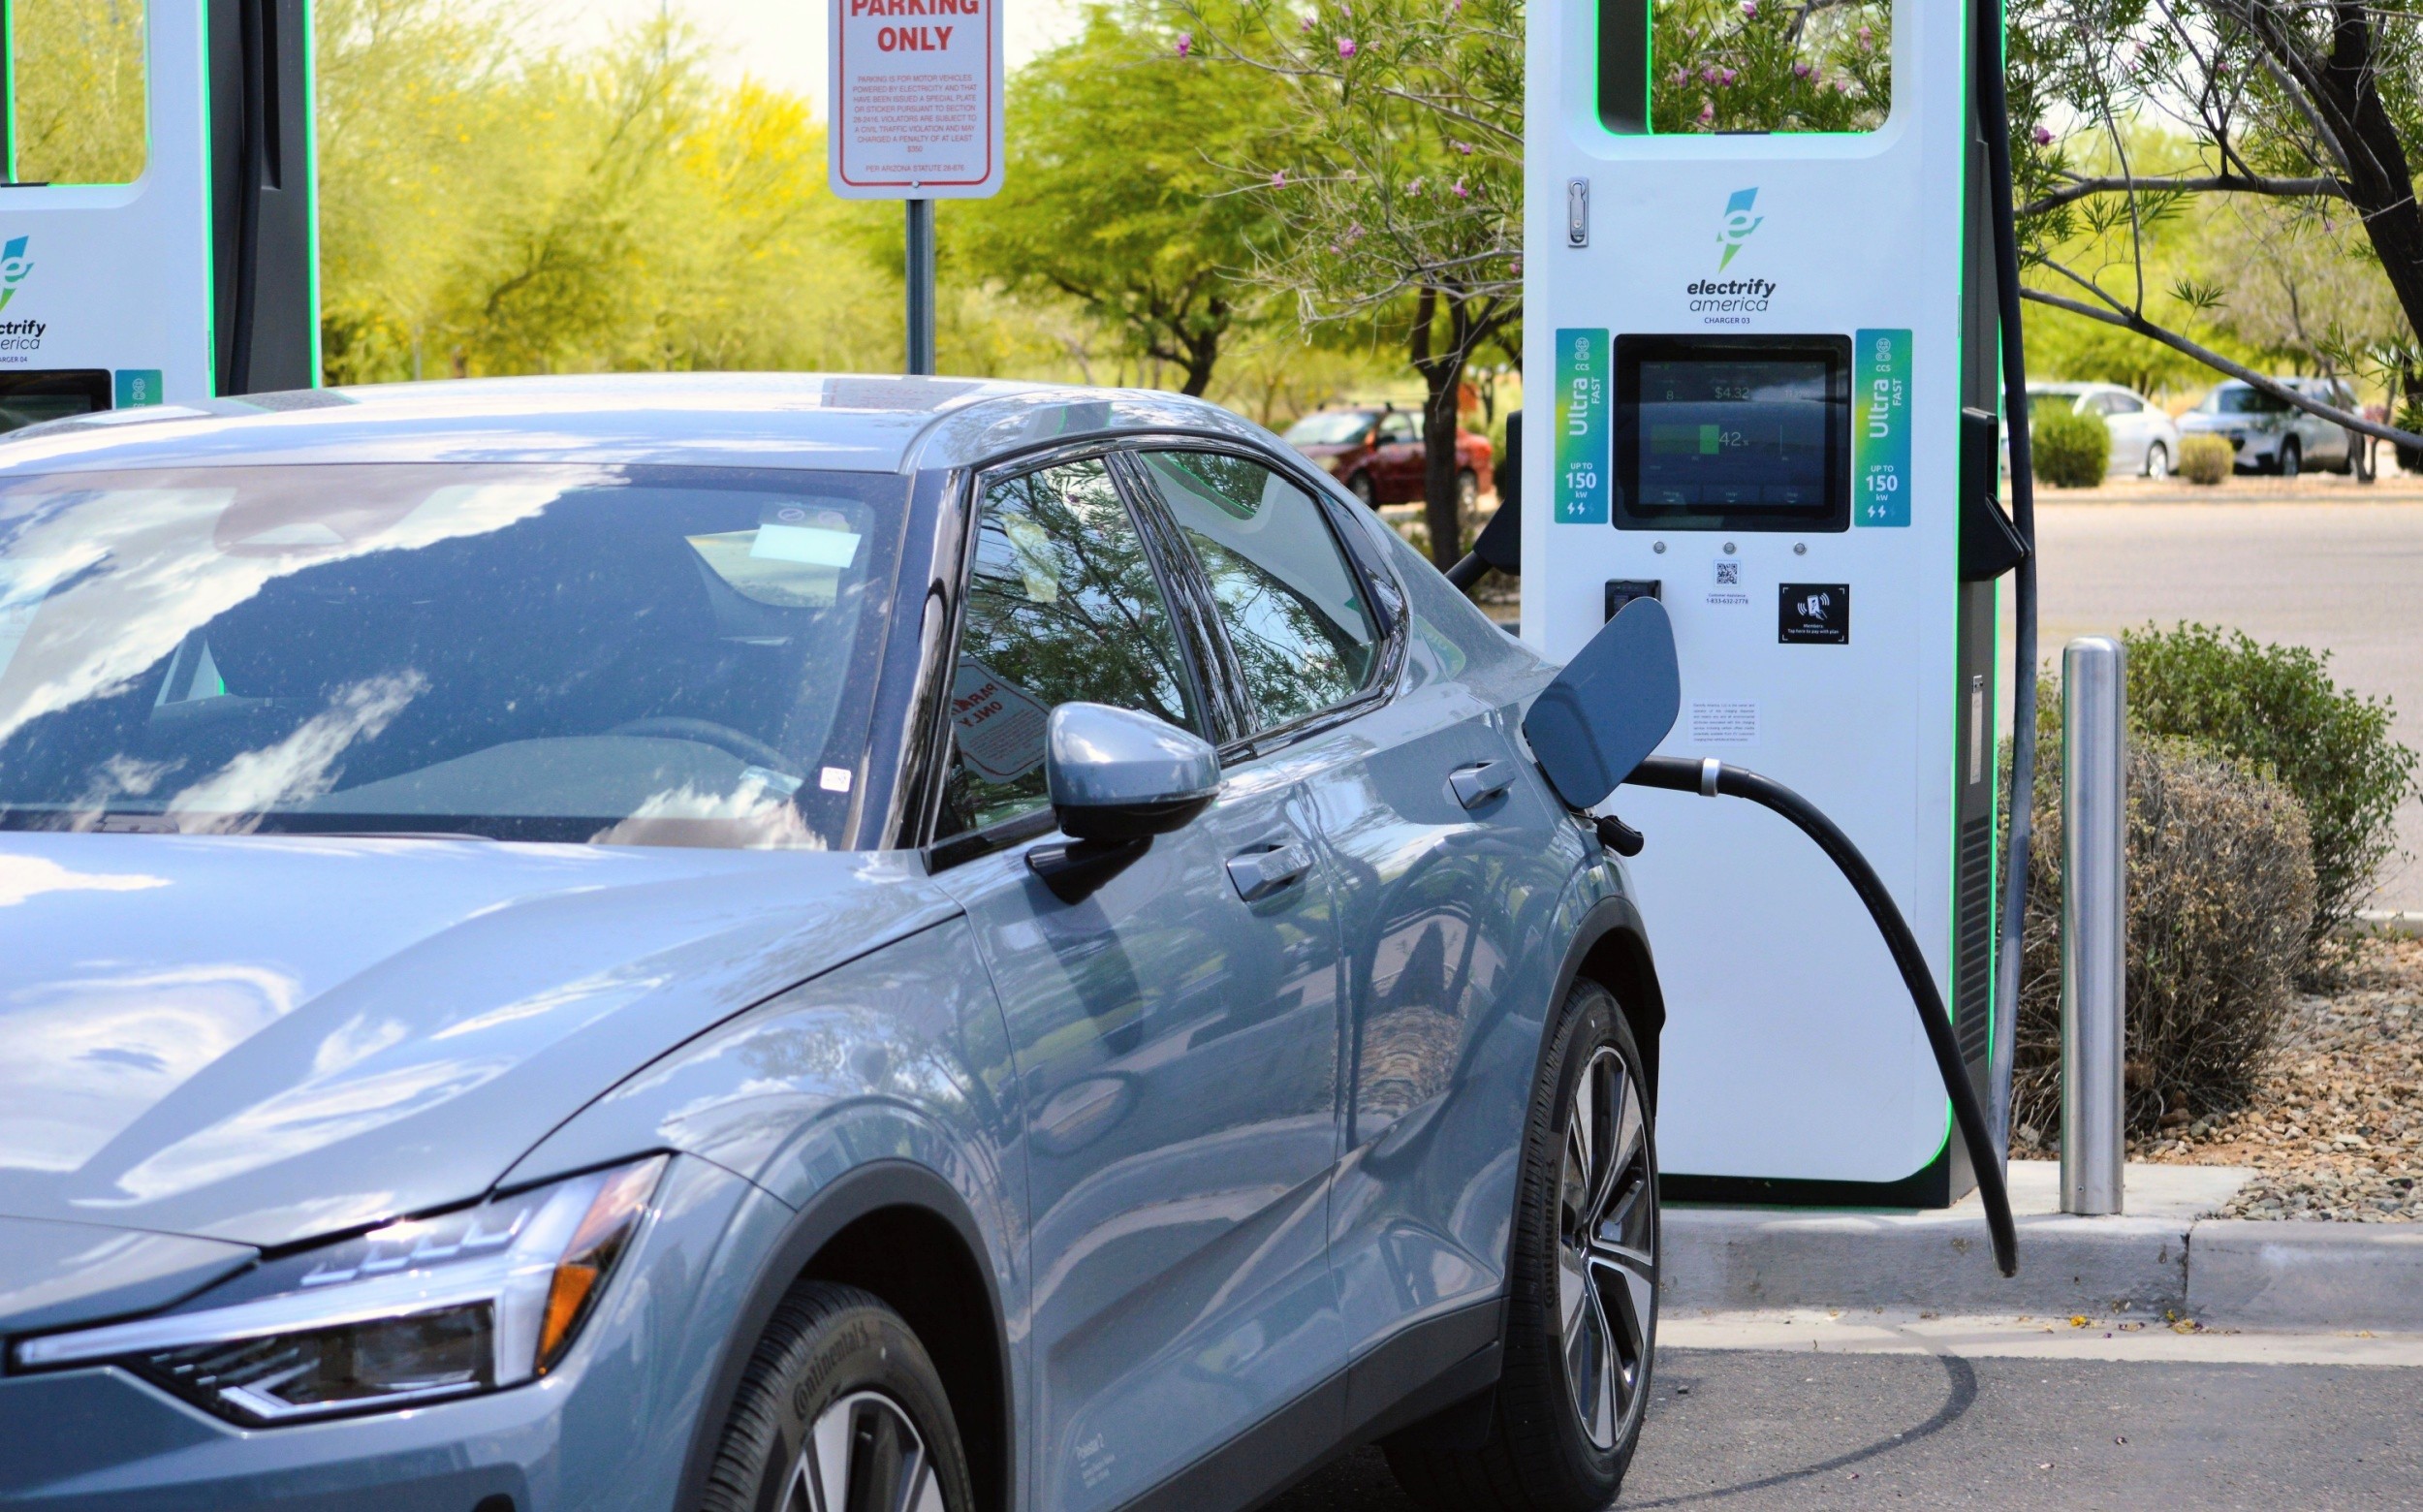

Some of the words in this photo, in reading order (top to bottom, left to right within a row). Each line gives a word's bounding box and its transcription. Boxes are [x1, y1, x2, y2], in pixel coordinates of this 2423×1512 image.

[851, 0, 979, 16] PARKING
[877, 26, 954, 51] ONLY
[1686, 278, 1777, 299] electrify
[1689, 297, 1769, 312] america
[0, 320, 47, 337] ctrify
[0, 336, 41, 350] erica
[1590, 377, 1601, 405] FAST
[1666, 391, 1674, 400] 8
[1715, 387, 1749, 400] $4.32
[1892, 378, 1902, 406] FAST
[1567, 377, 1589, 436] Ultra
[1868, 378, 1889, 438] Ultra
[1565, 472, 1597, 489] 150
[1866, 475, 1898, 491] 150
[1542, 1177, 1557, 1309] Continental
[793, 1322, 861, 1421] Continental
